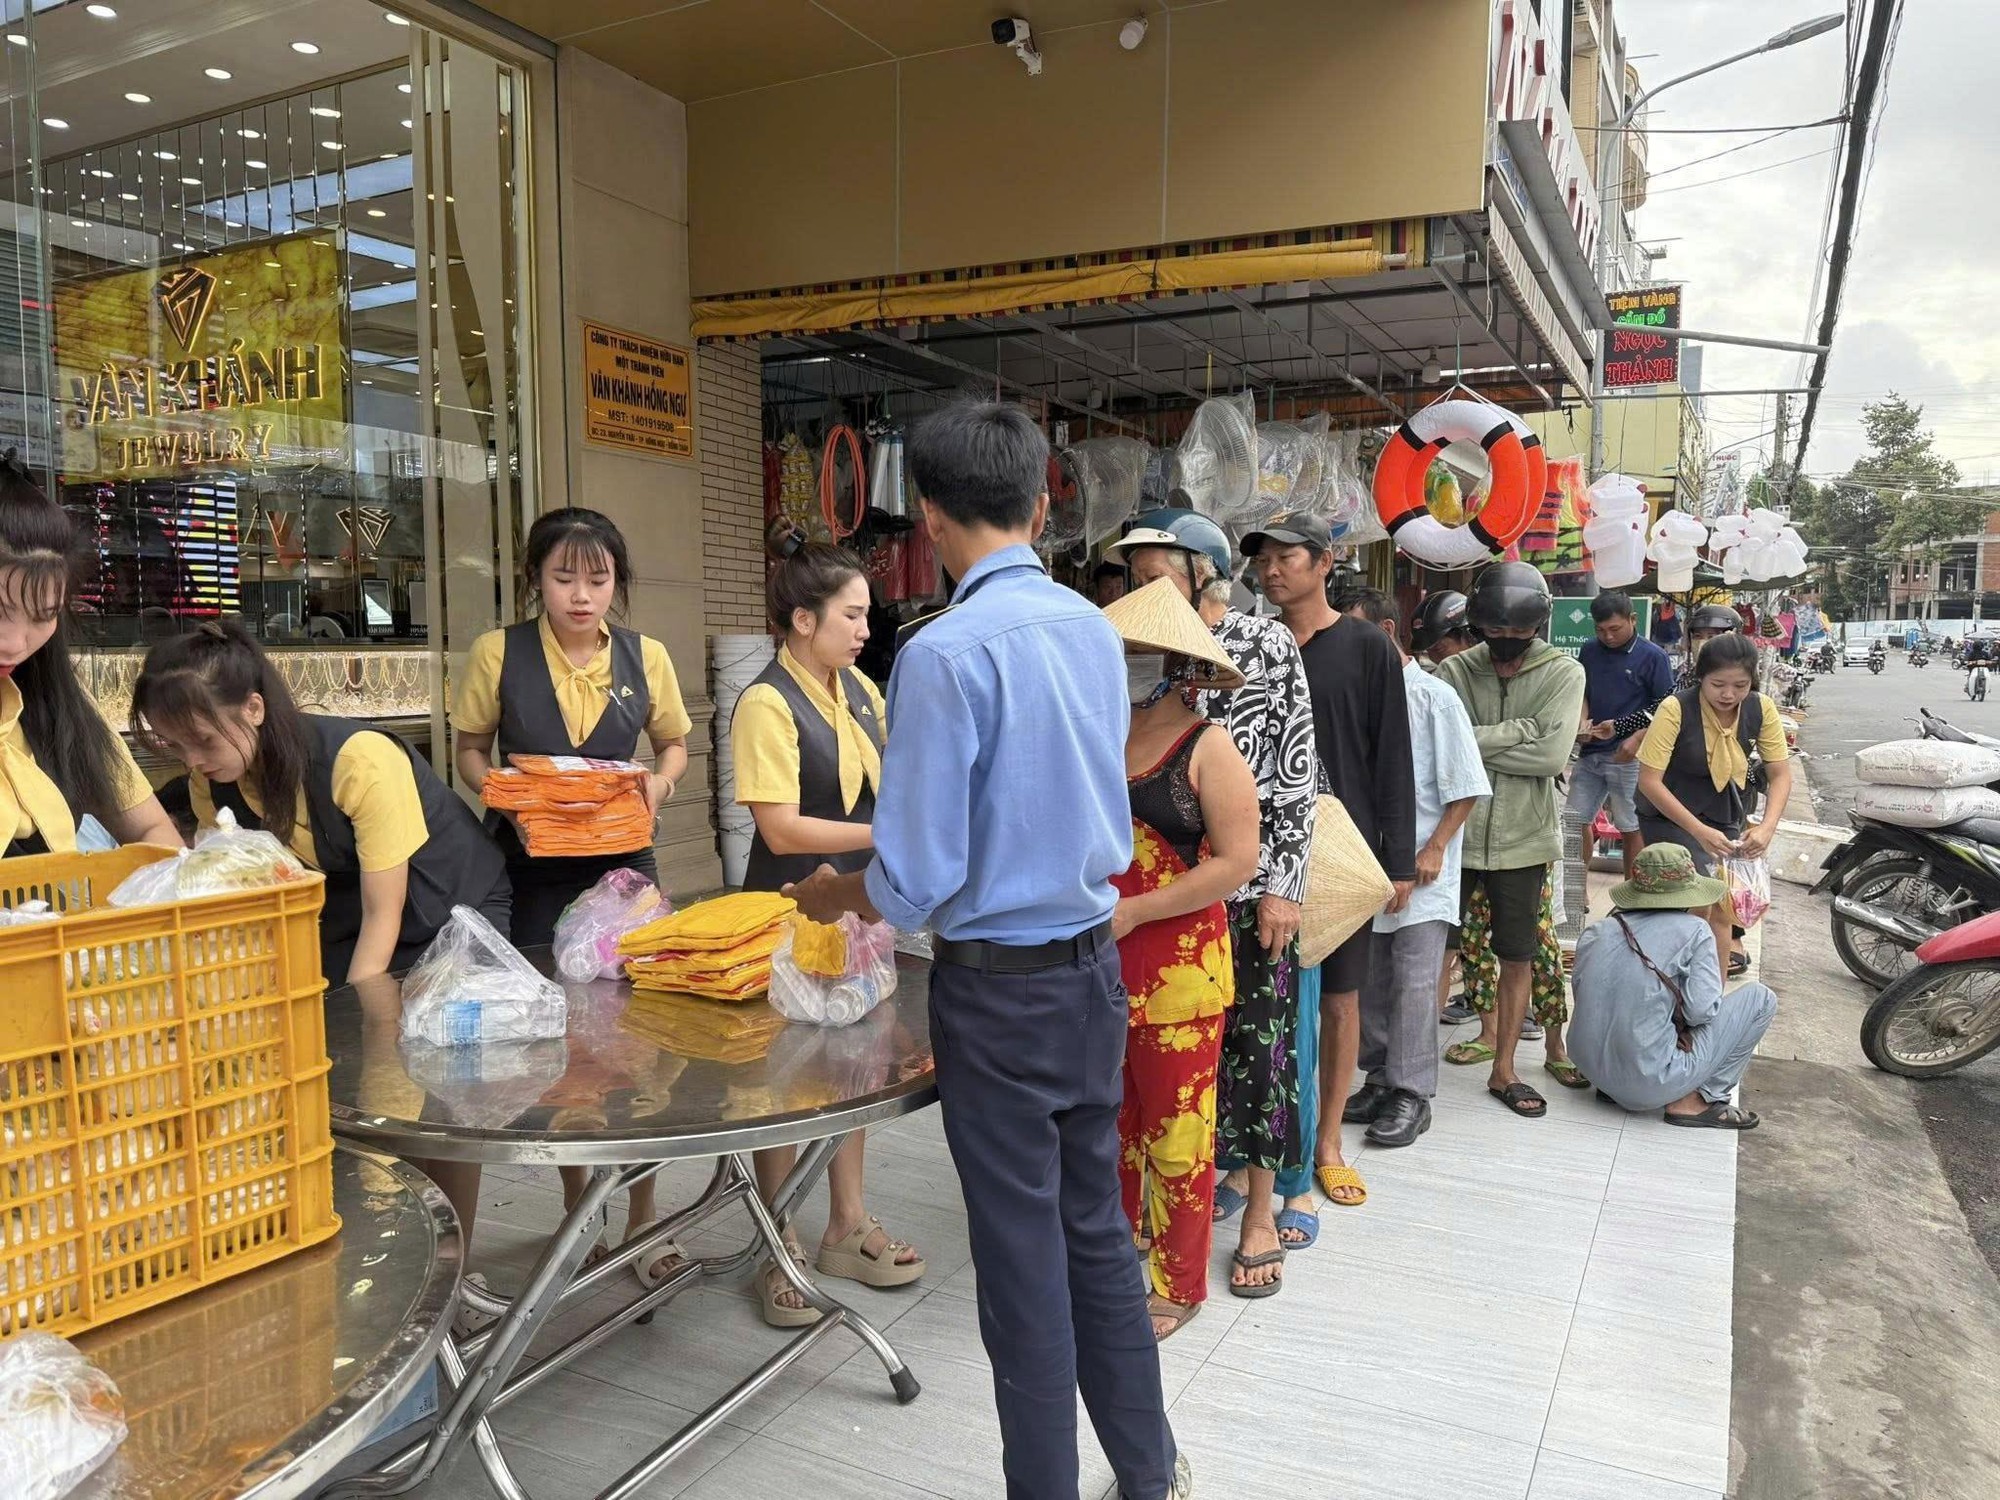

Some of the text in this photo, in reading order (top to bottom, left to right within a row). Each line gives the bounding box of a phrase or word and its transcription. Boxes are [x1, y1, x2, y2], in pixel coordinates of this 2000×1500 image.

[1609, 292, 1676, 312] TIỆM VÀNG
[71, 337, 324, 425] VÂN KHÁNH
[591, 369, 610, 400] VÂN
[611, 376, 643, 408] KHÁNH
[643, 381, 668, 413] HỒNG
[608, 409, 629, 423] MST:
[117, 423, 273, 471] JEWELRY
[1555, 635, 1566, 644] Hệ
